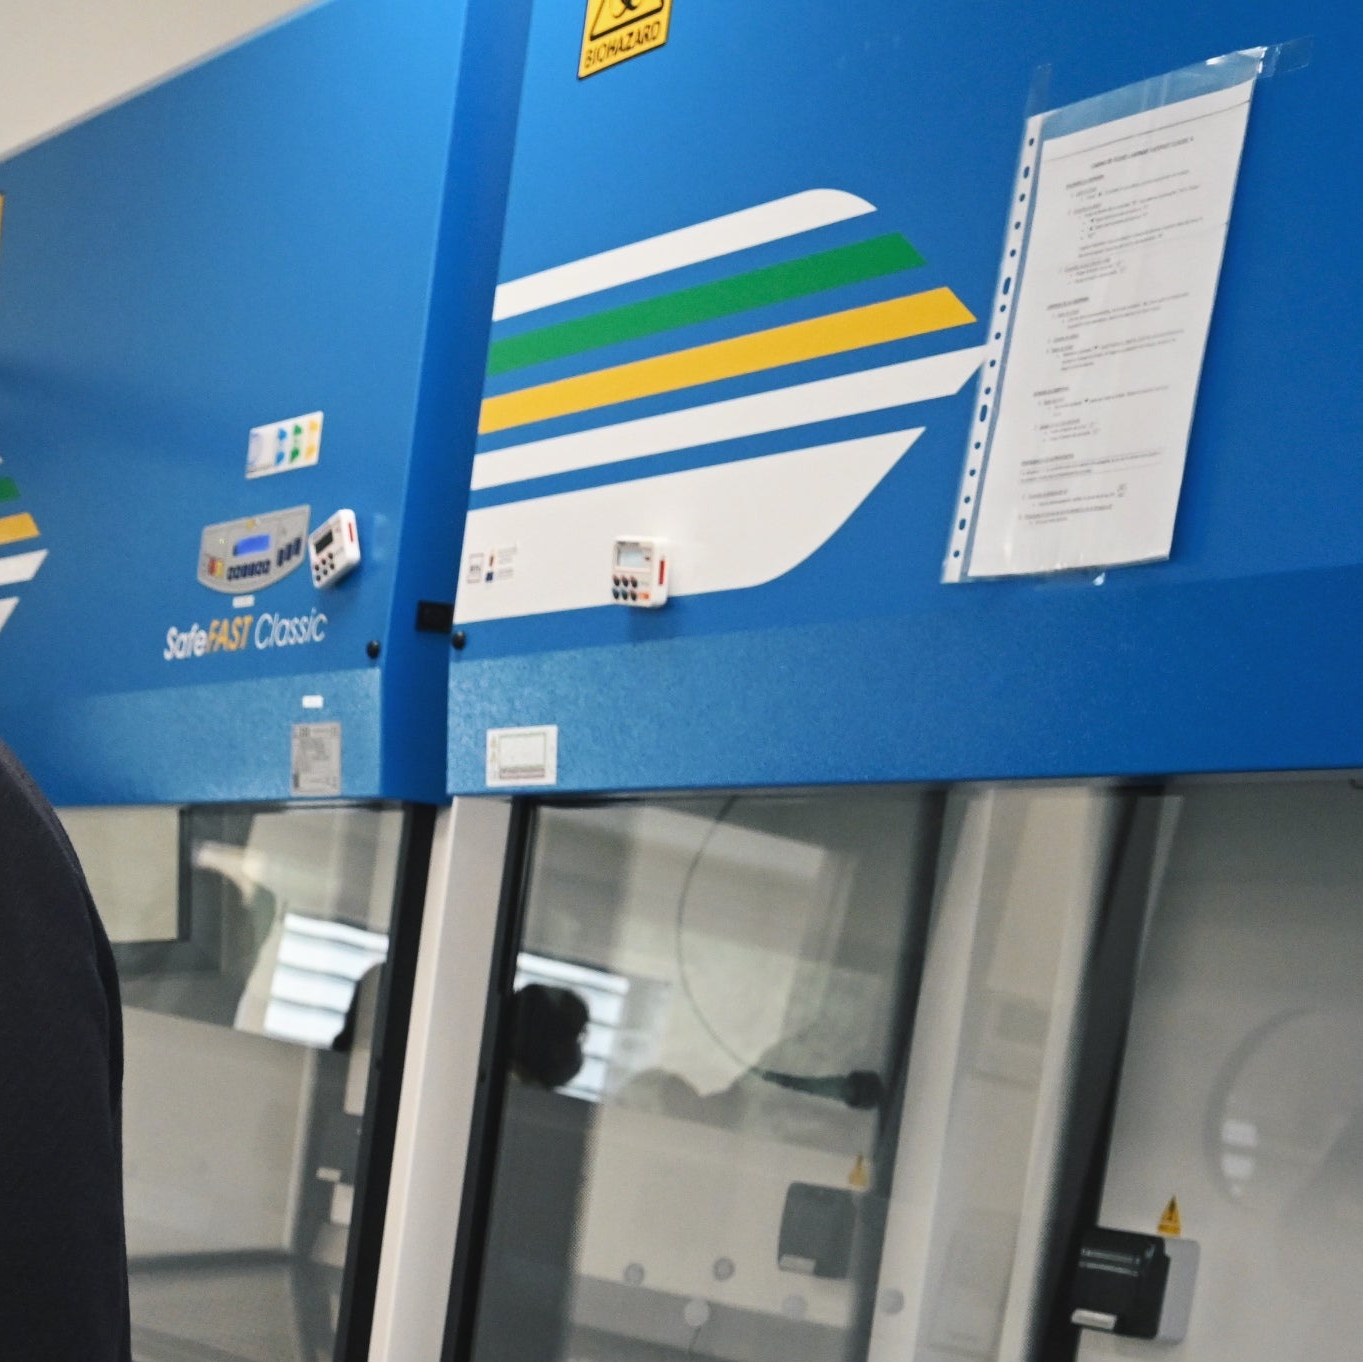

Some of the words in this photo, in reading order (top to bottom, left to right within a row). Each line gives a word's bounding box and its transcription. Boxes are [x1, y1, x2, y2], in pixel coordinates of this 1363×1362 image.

[584, 21, 661, 69] BIOHAZARD
[163, 614, 254, 661] SafeFAST
[254, 606, 328, 650] Classic
